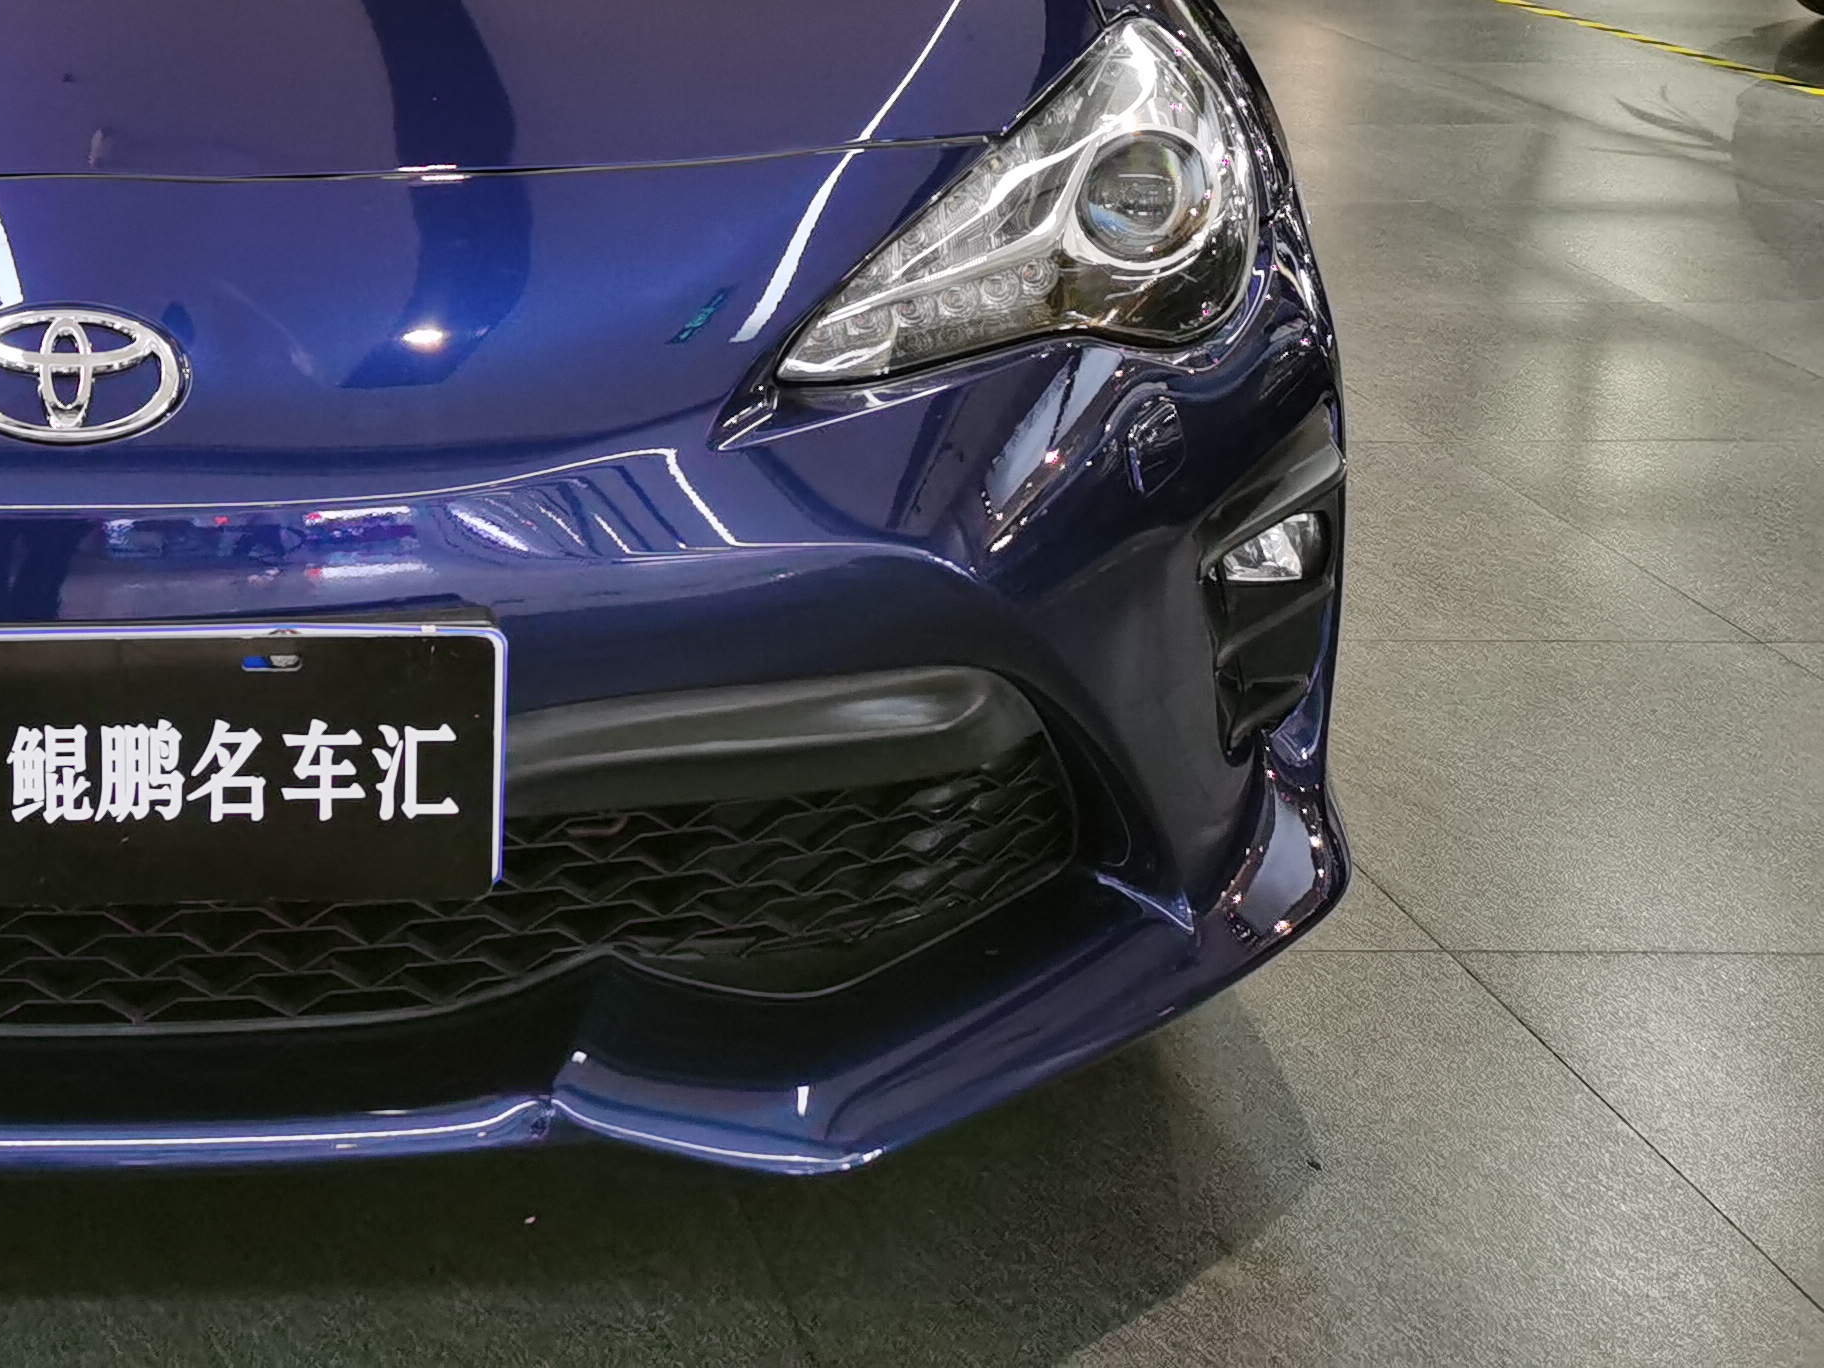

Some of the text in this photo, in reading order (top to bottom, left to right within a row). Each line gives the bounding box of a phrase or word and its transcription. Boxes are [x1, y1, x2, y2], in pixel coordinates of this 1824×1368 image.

[5, 718, 460, 825] 鲲鹏名车汇
